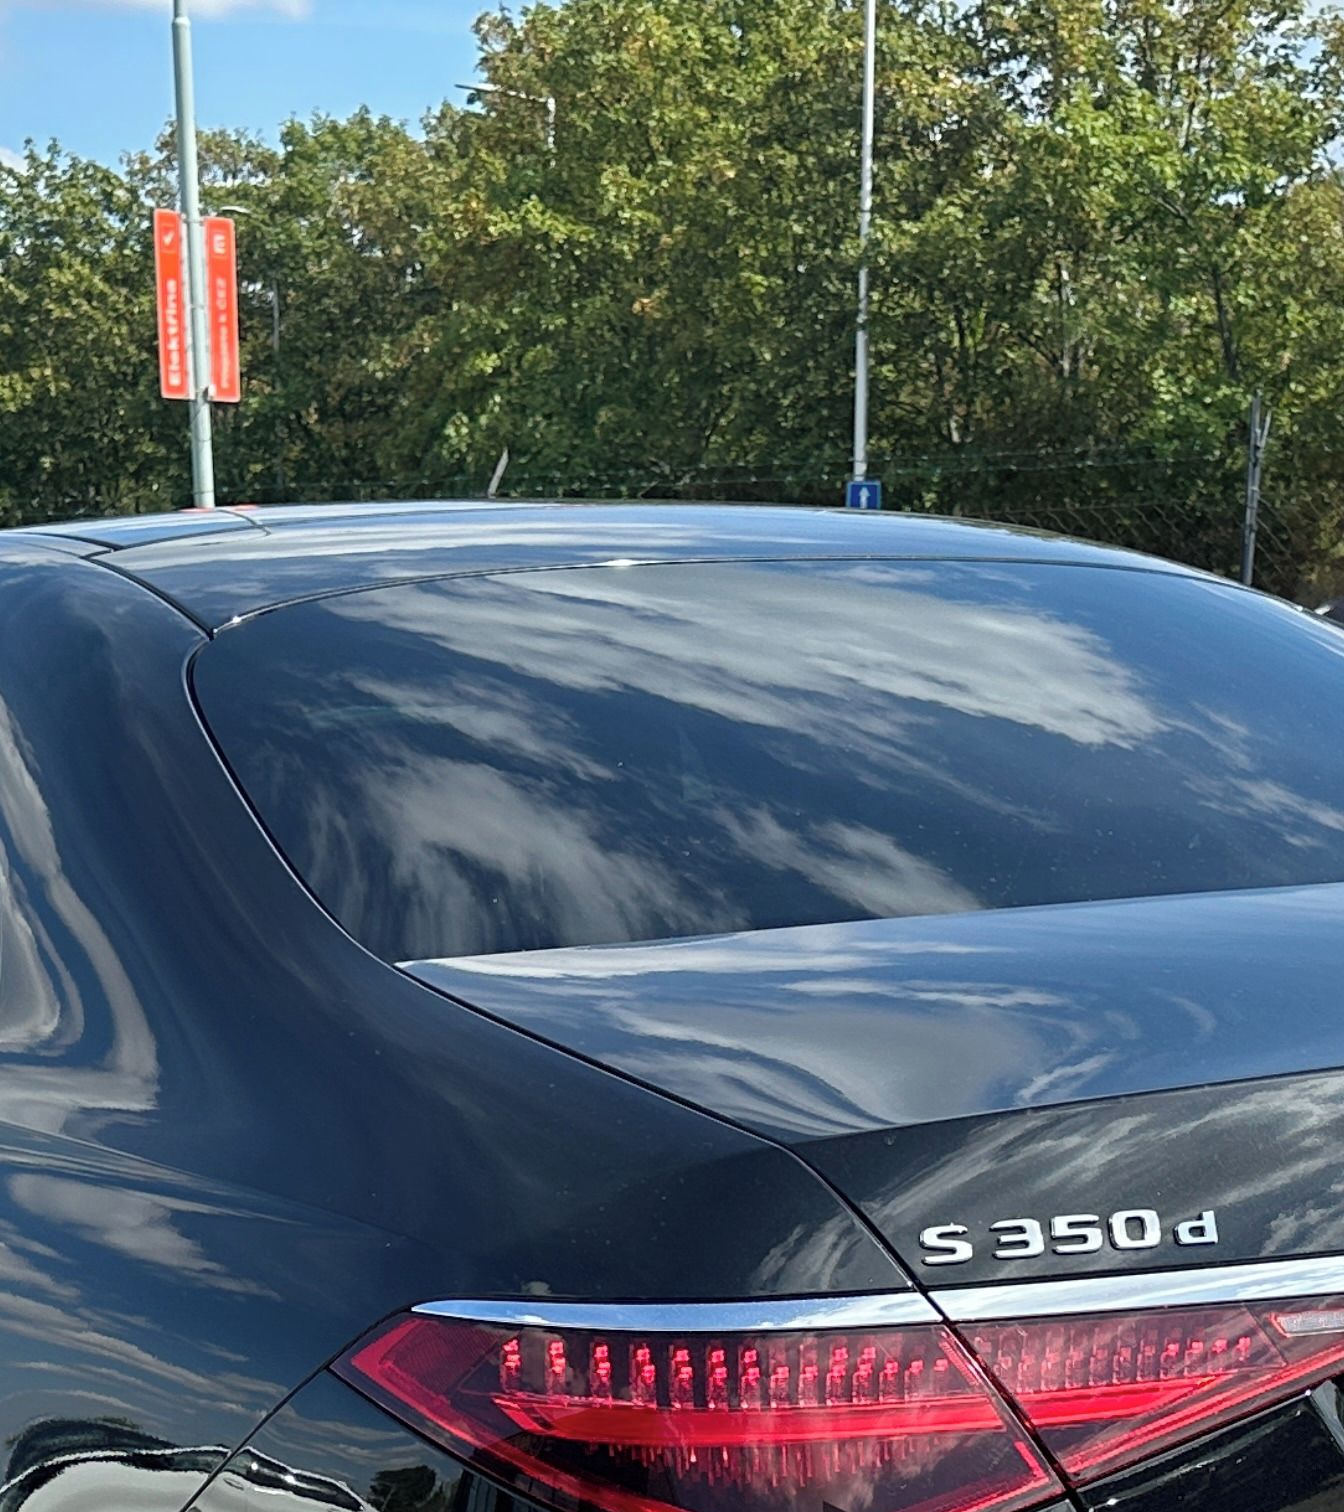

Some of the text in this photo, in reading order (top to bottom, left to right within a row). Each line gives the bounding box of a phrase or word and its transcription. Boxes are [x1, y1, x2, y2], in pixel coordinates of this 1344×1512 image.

[920, 1208, 1220, 1266] S 350 d
